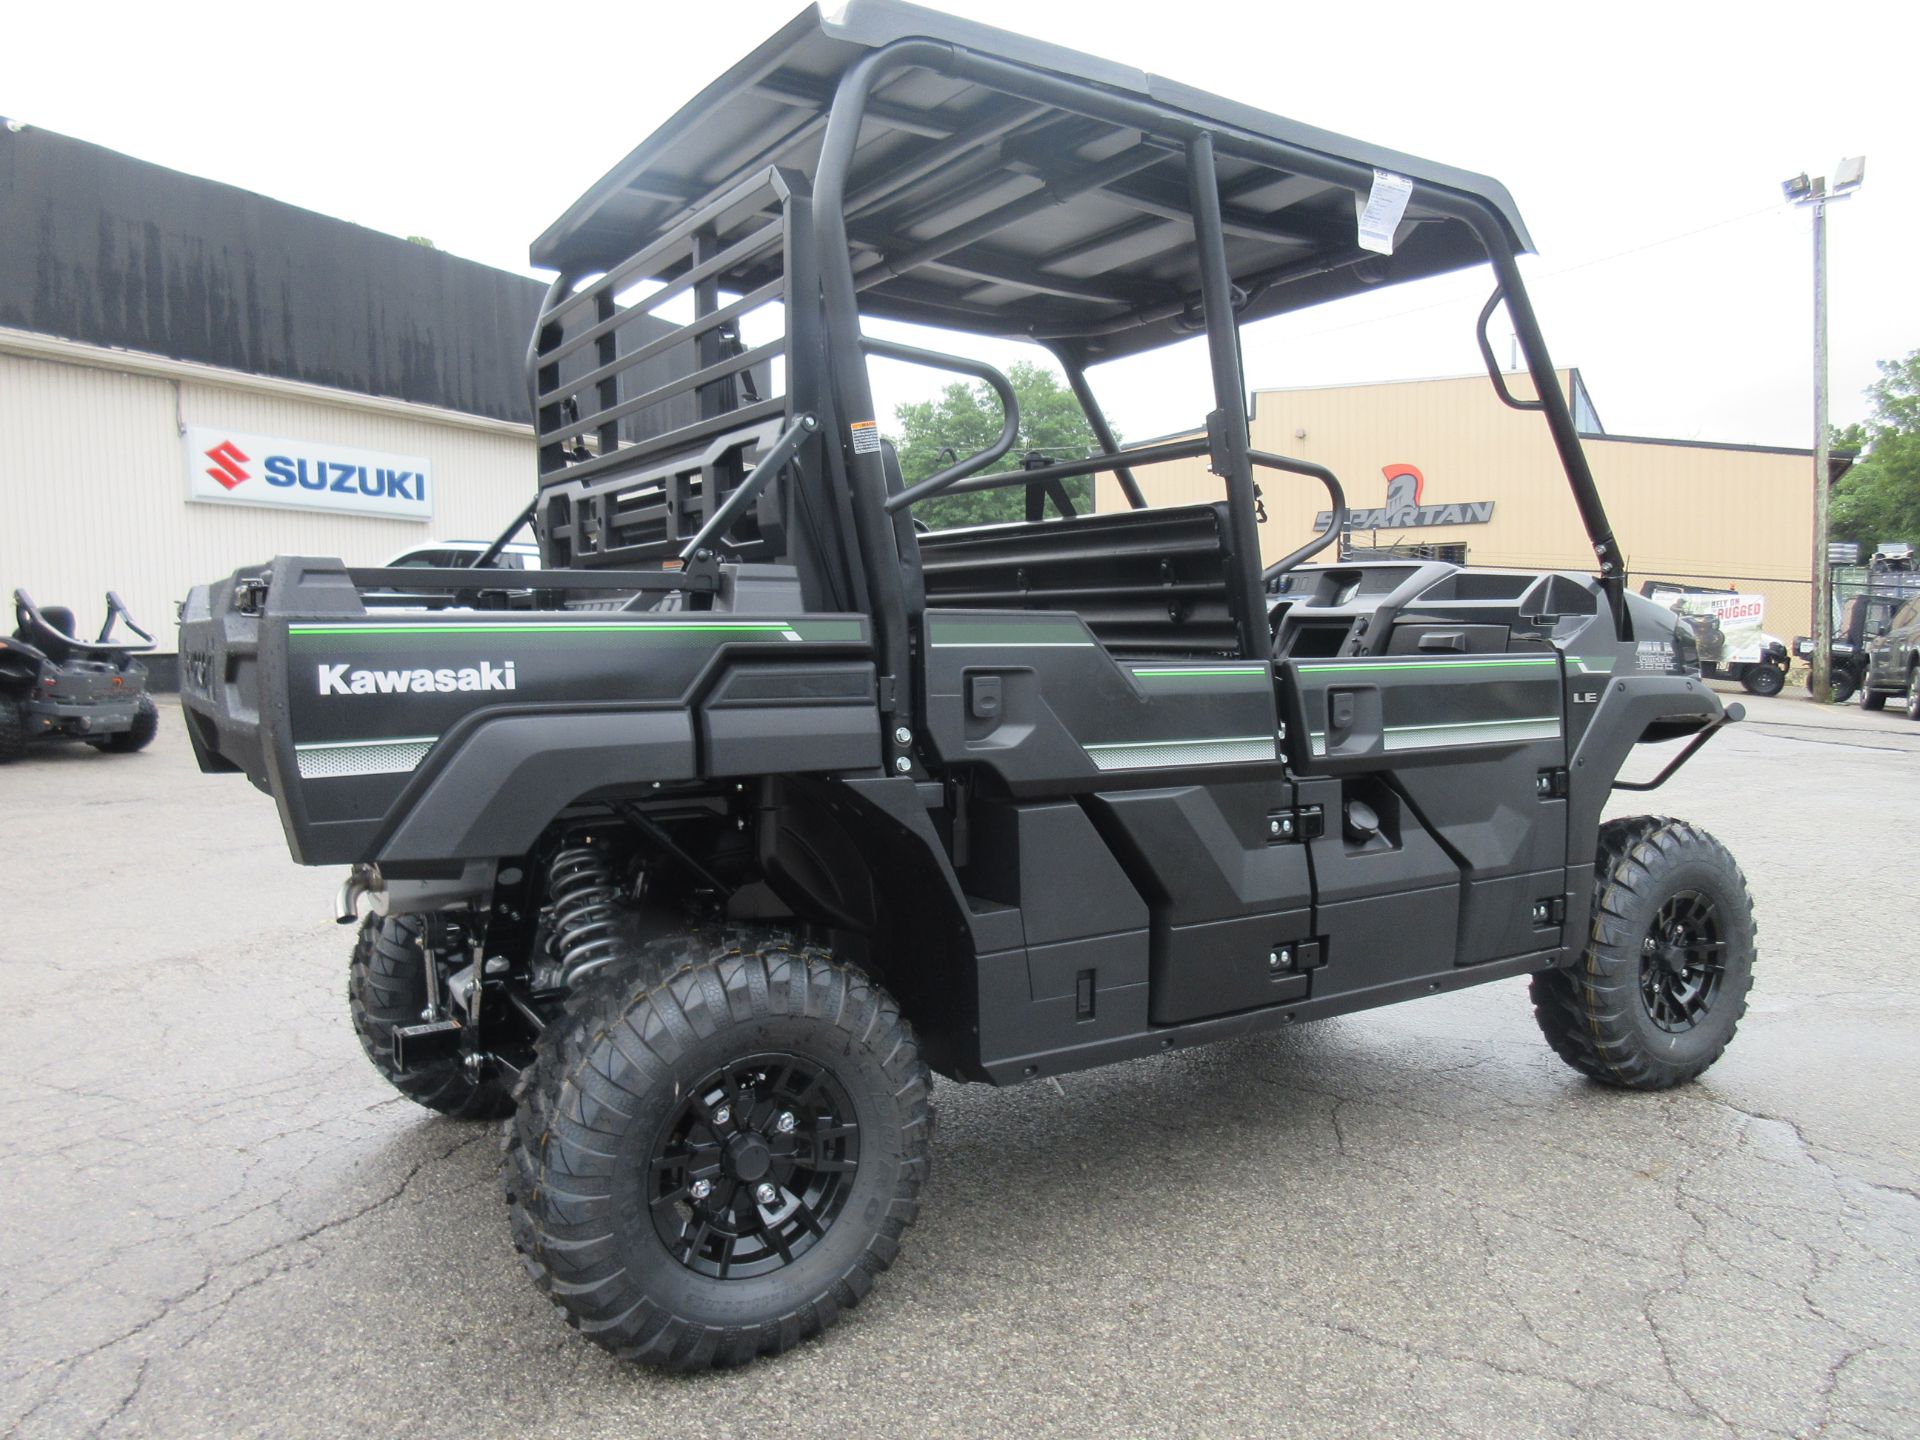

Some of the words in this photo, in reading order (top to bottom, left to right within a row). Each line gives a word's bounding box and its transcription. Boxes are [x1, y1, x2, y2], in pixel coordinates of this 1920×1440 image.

[264, 455, 424, 501] SUZUKI
[1717, 603, 1761, 620] RUGGED
[318, 661, 516, 695] Kawasaki
[1573, 692, 1598, 703] LE
